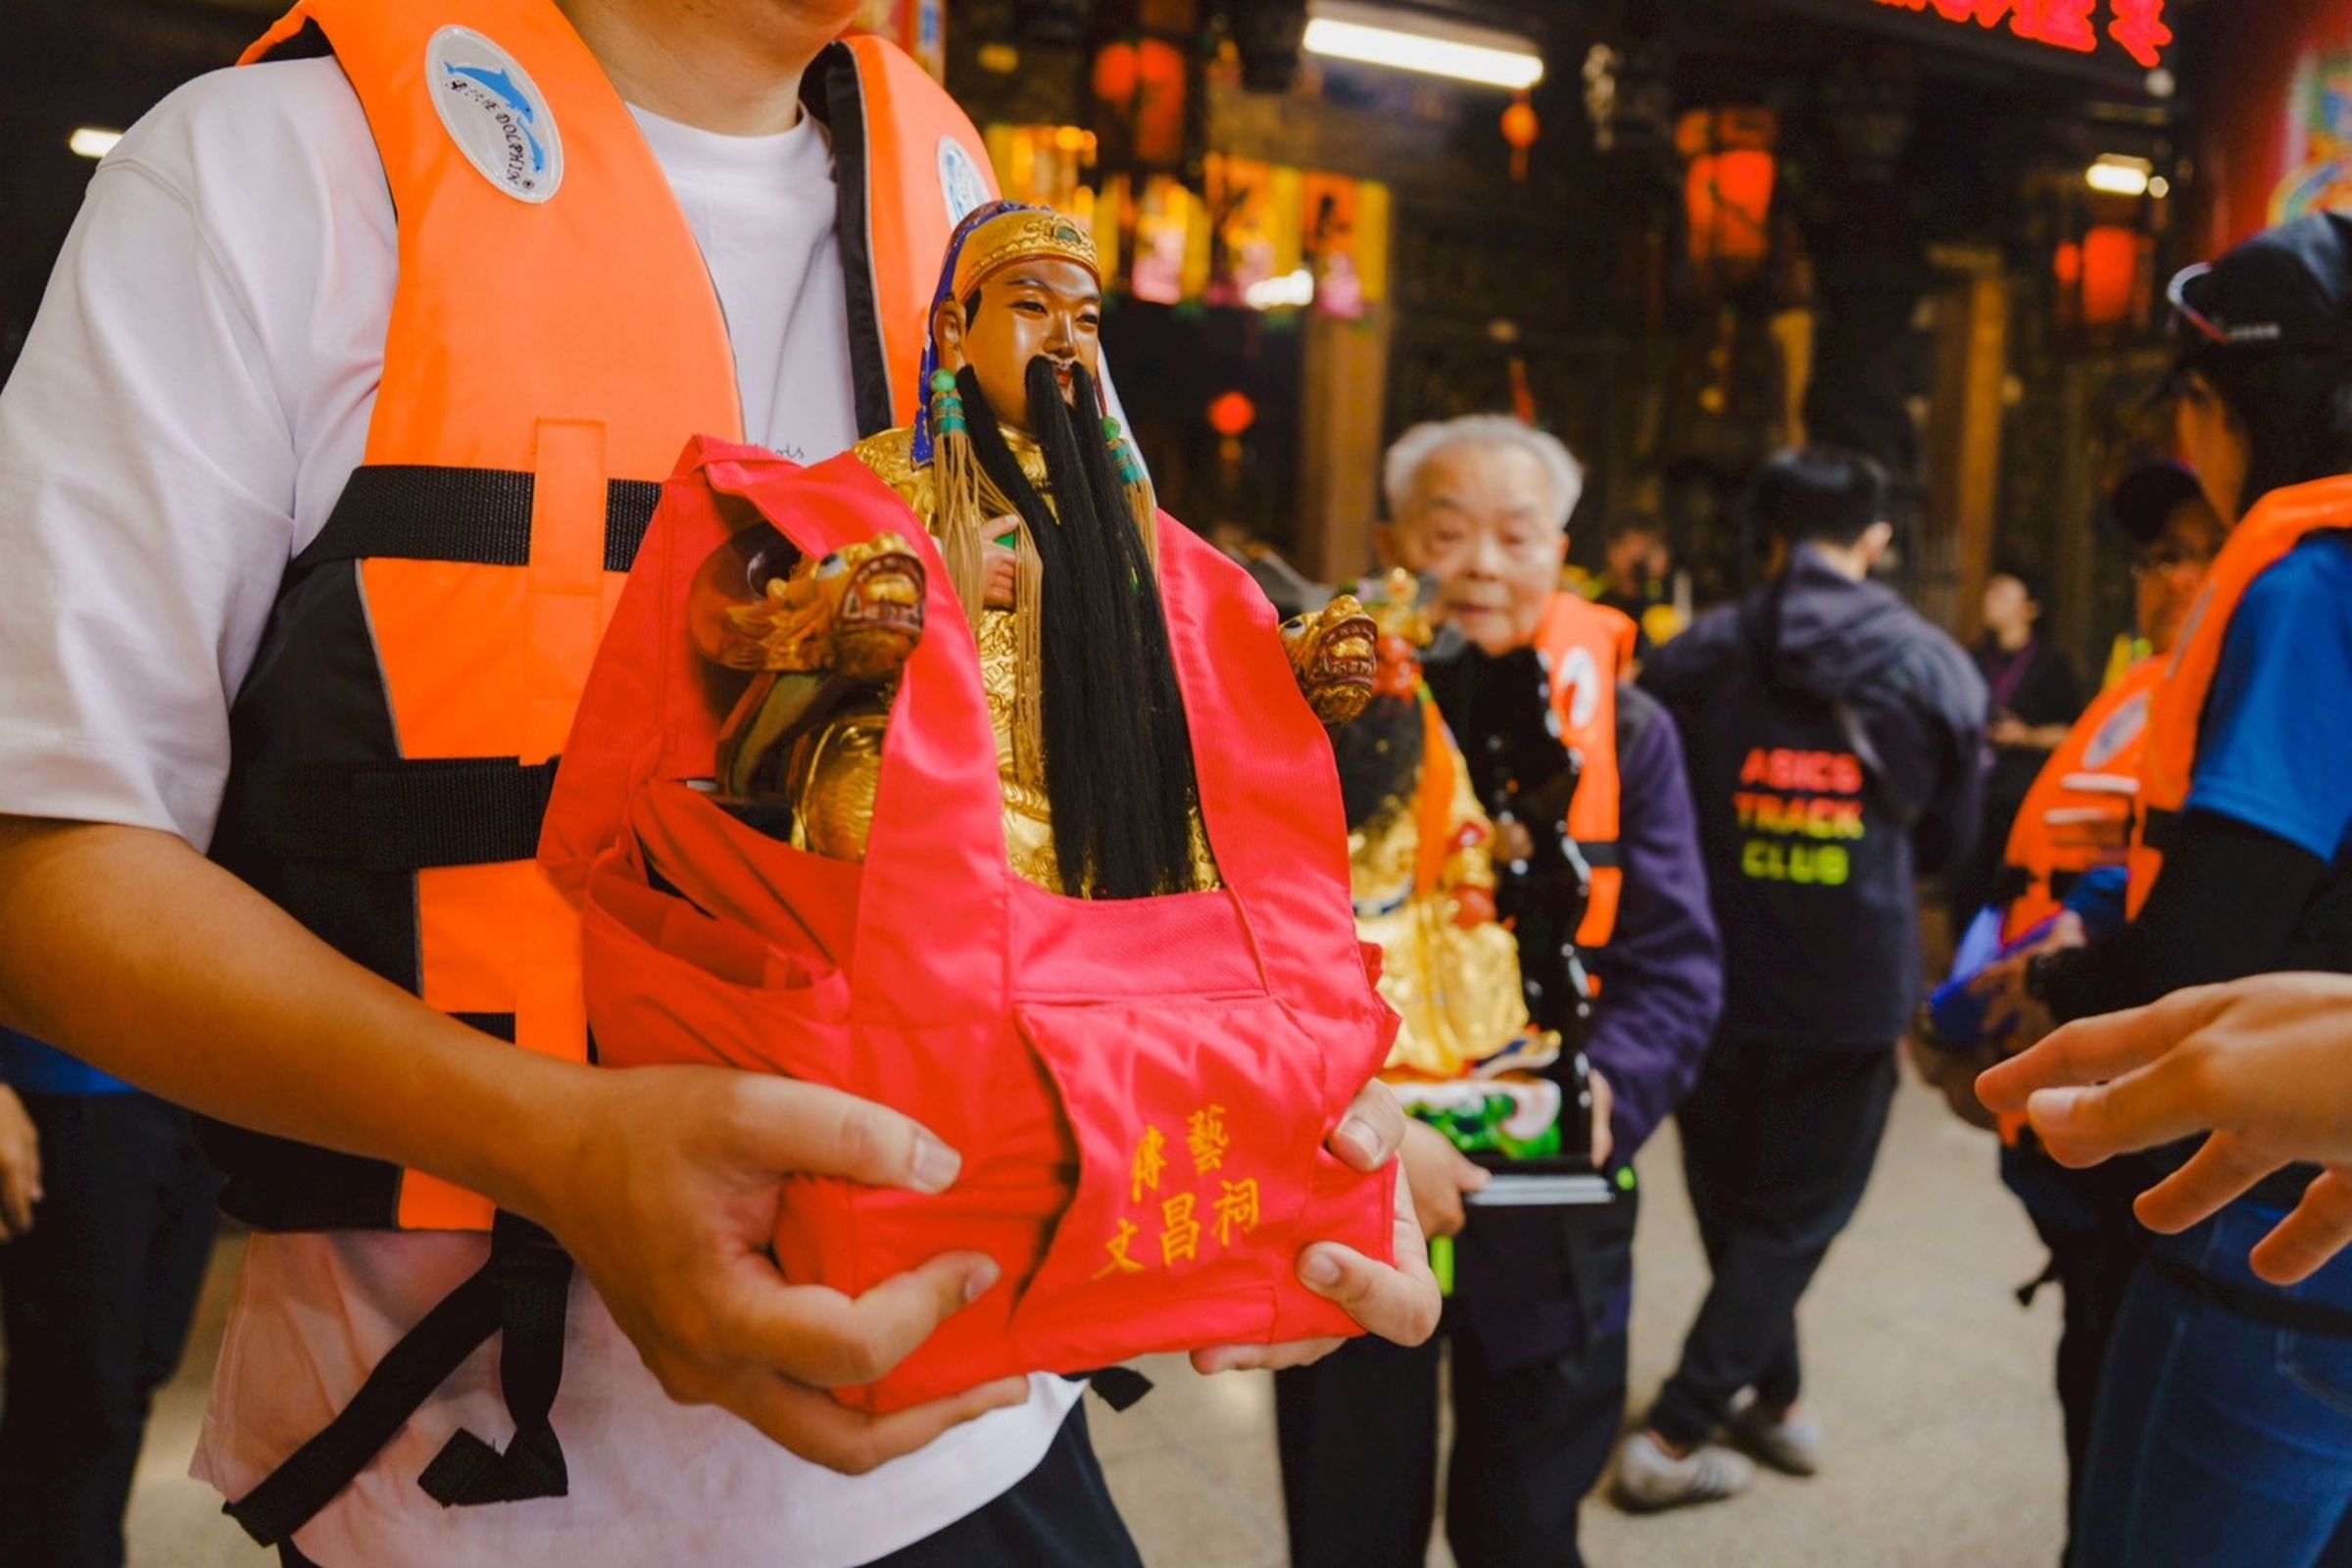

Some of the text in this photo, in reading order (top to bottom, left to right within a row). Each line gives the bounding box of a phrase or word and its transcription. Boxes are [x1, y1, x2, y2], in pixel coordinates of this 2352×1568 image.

[496, 114, 525, 185] DOLPHIN
[1740, 748, 1863, 794] ASICS
[1734, 792, 1865, 840] TRACK
[1742, 839, 1849, 885] CLUB
[1092, 1178, 1258, 1280] 文昌祠
